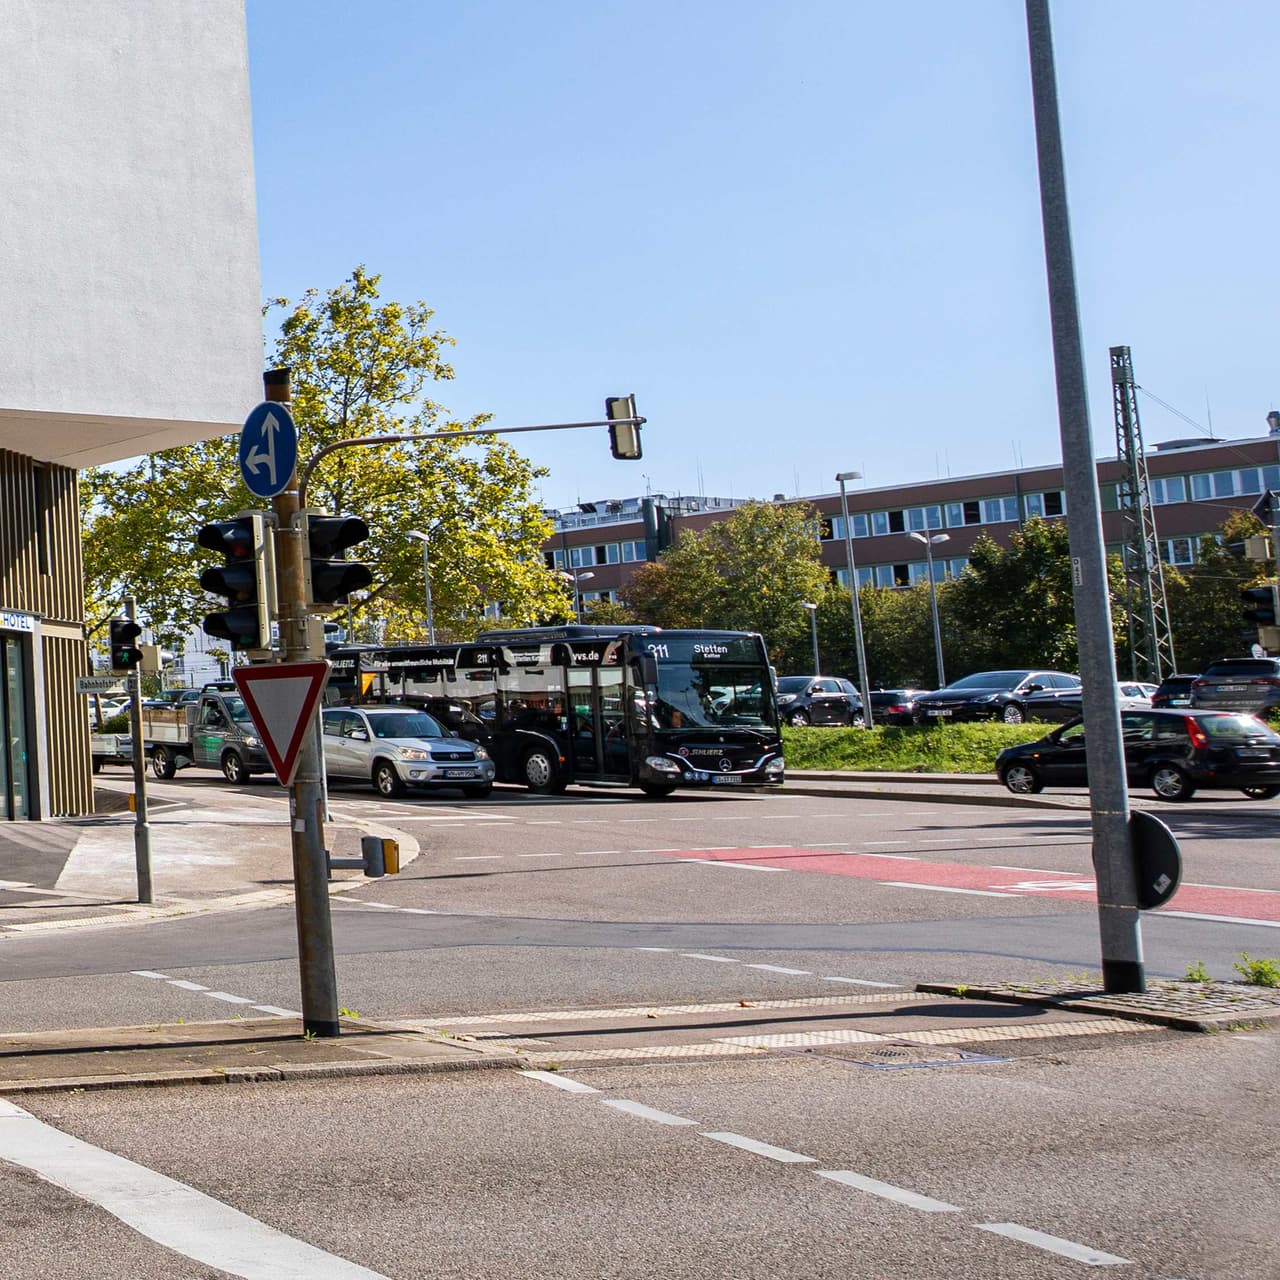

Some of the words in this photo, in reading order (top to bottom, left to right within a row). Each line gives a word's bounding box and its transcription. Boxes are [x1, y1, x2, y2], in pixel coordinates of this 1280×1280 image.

[3, 613, 30, 629] HOTEL
[693, 644, 728, 654] Stetten
[79, 679, 126, 690] Bahnhofstra
